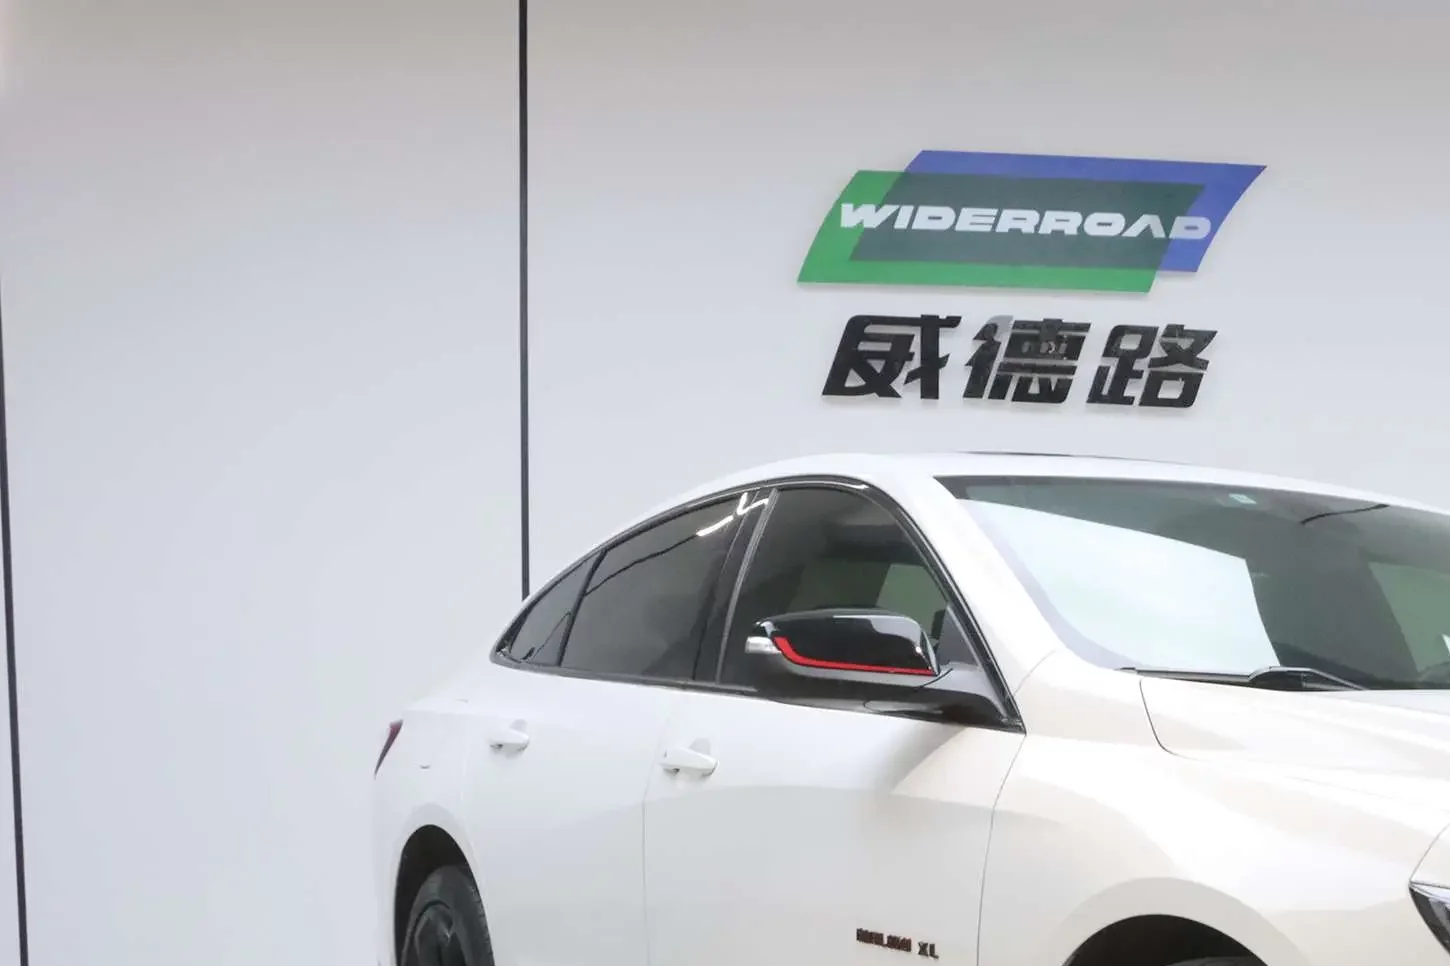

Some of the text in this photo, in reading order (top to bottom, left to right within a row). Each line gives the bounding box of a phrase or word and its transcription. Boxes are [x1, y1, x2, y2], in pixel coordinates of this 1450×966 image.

[840, 203, 1211, 240] WIDERROAD
[821, 313, 1218, 408] 威德路
[918, 941, 940, 959] XL
